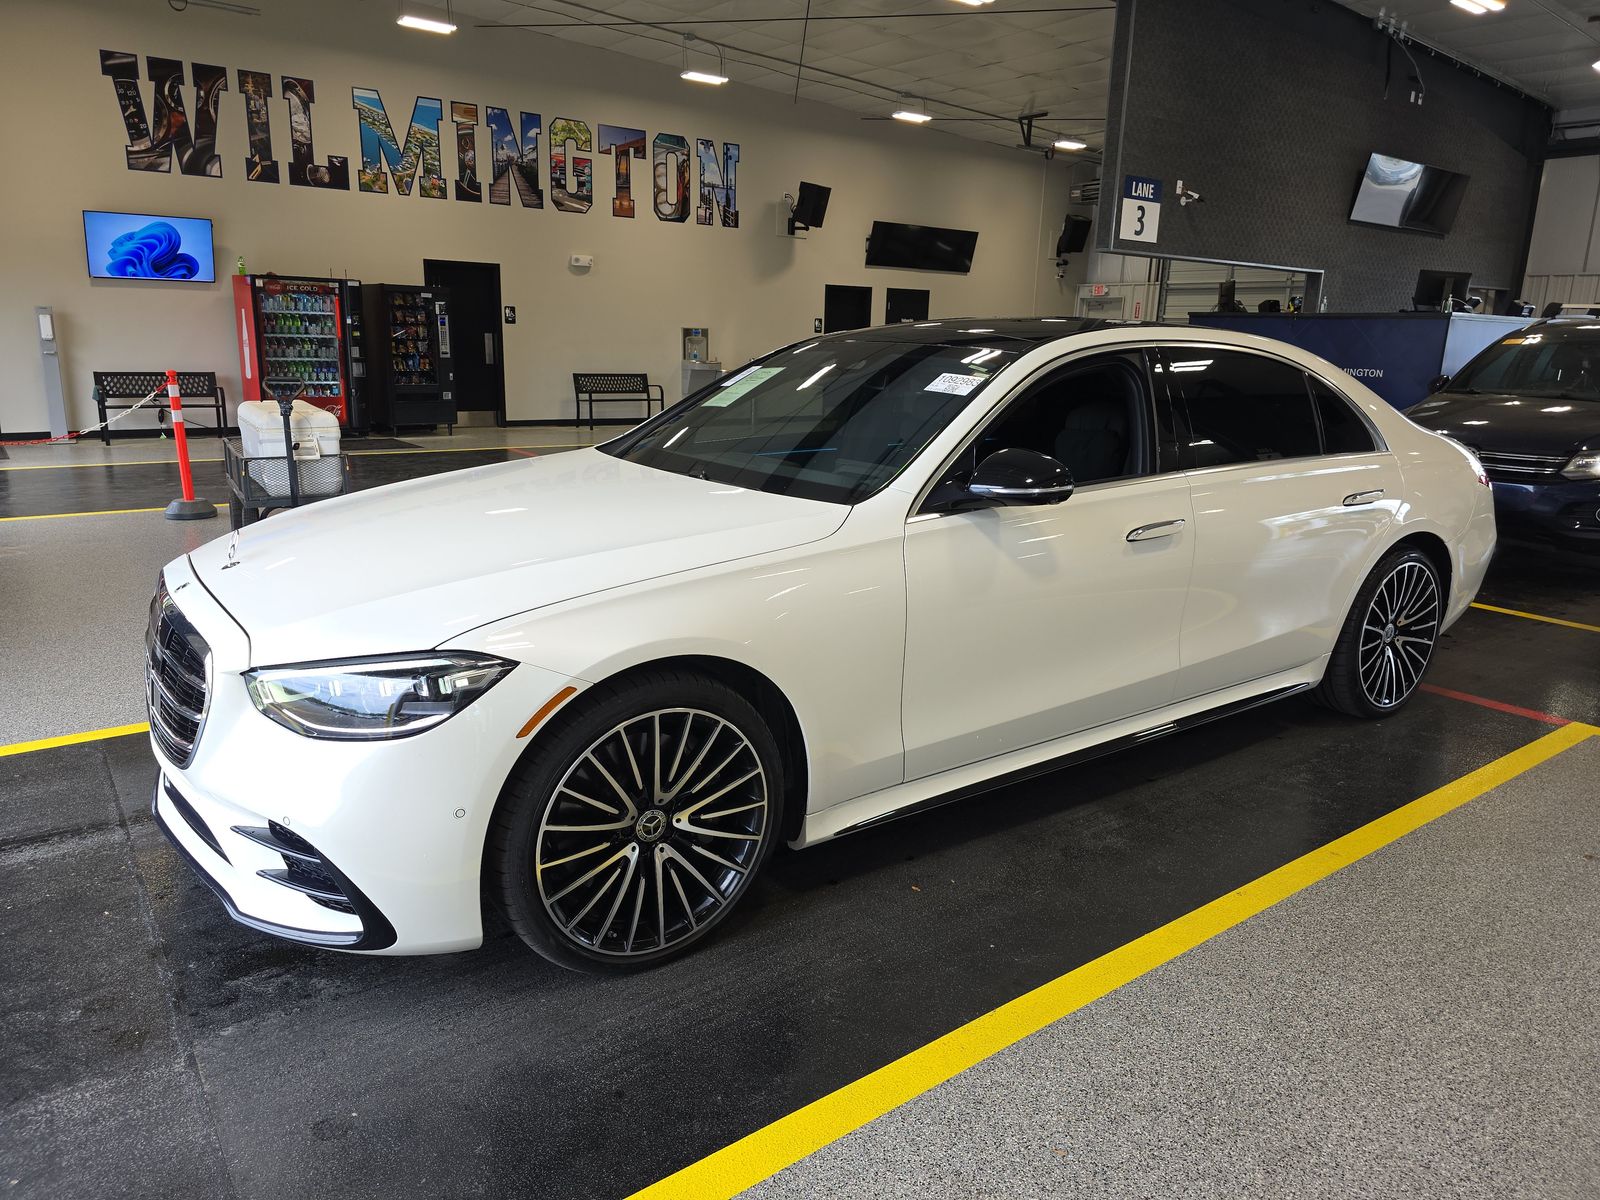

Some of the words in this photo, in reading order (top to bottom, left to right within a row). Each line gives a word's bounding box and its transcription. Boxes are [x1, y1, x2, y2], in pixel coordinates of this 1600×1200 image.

[99, 49, 740, 228] WILMINGTON
[1131, 181, 1154, 199] LANE
[1134, 205, 1145, 236] 3
